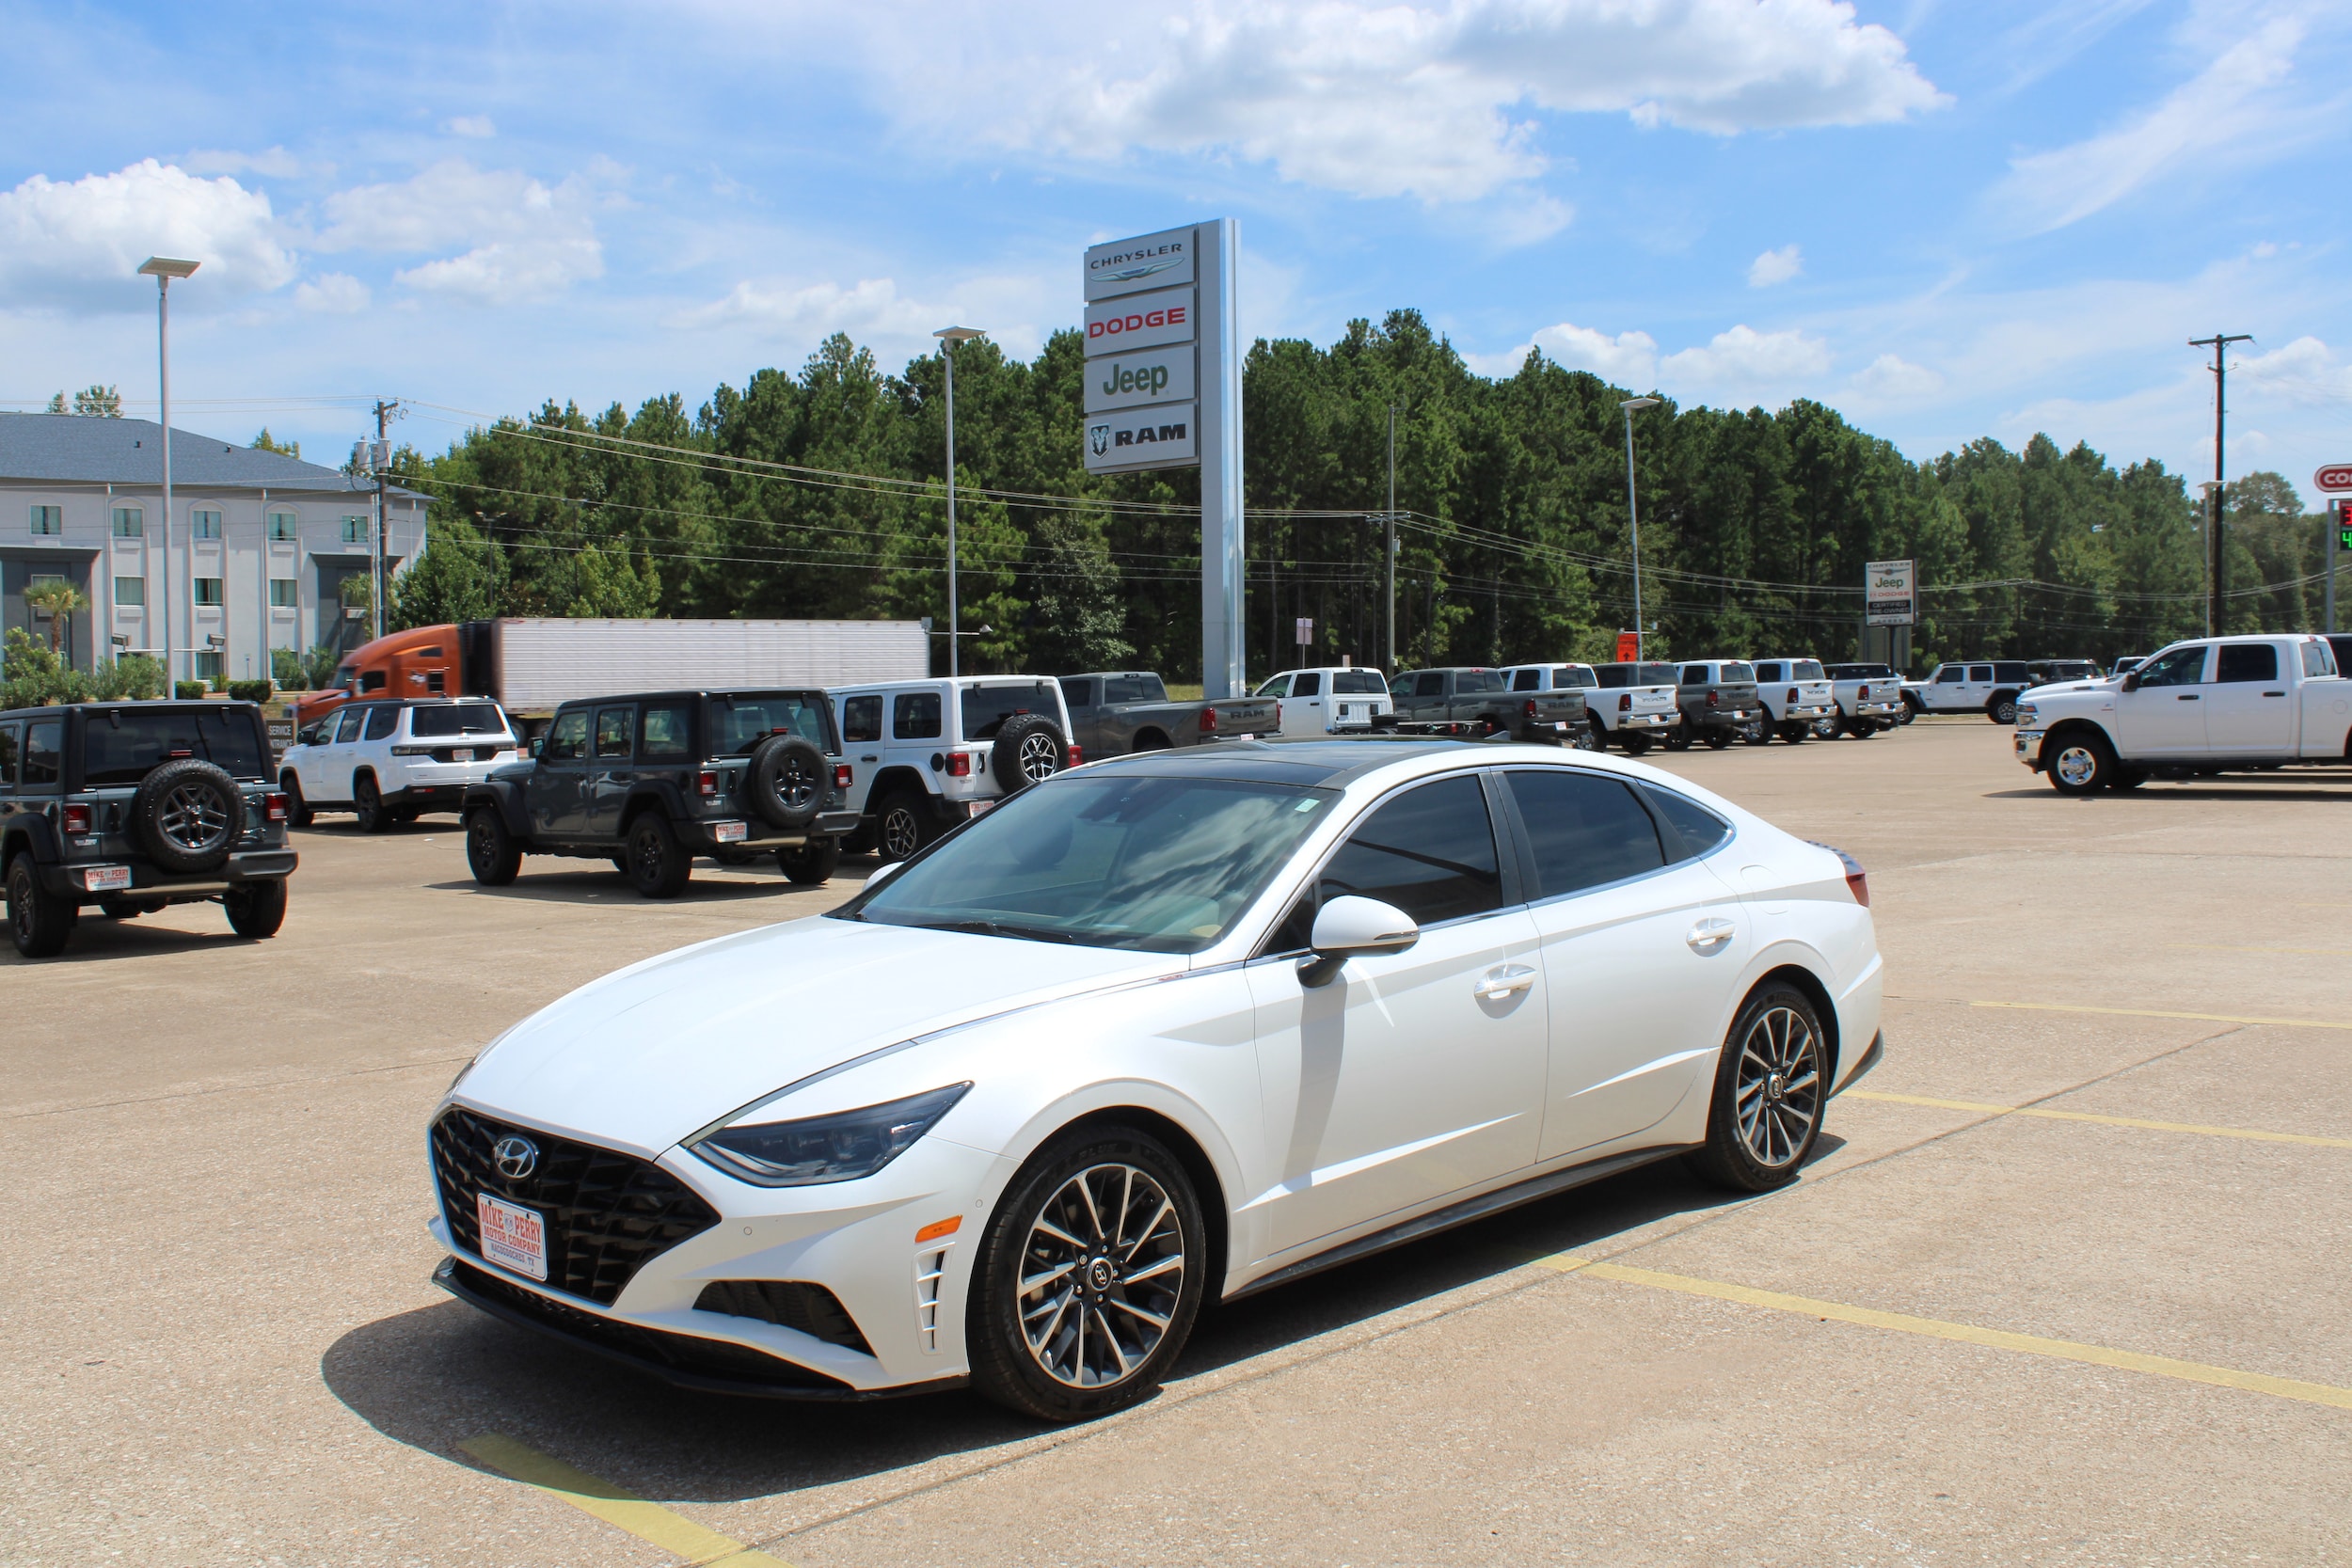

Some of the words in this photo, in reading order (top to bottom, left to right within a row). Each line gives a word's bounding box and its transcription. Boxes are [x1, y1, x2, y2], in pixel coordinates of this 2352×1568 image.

[1090, 243, 1183, 270] CHRYSLER
[1089, 307, 1185, 339] DODGE
[1103, 364, 1168, 396] Jeep
[1115, 423, 1186, 447] RAM
[2324, 472, 2352, 484] CO
[1875, 577, 1904, 589] Jeep
[1230, 709, 1265, 719] RAM
[268, 725, 292, 736] SERVICE
[270, 739, 293, 749] NTRANCE
[481, 1203, 504, 1230] MIKE
[514, 1215, 541, 1243] PERRY
[484, 1225, 506, 1243] MOTOR
[508, 1234, 541, 1255] COMPANY
